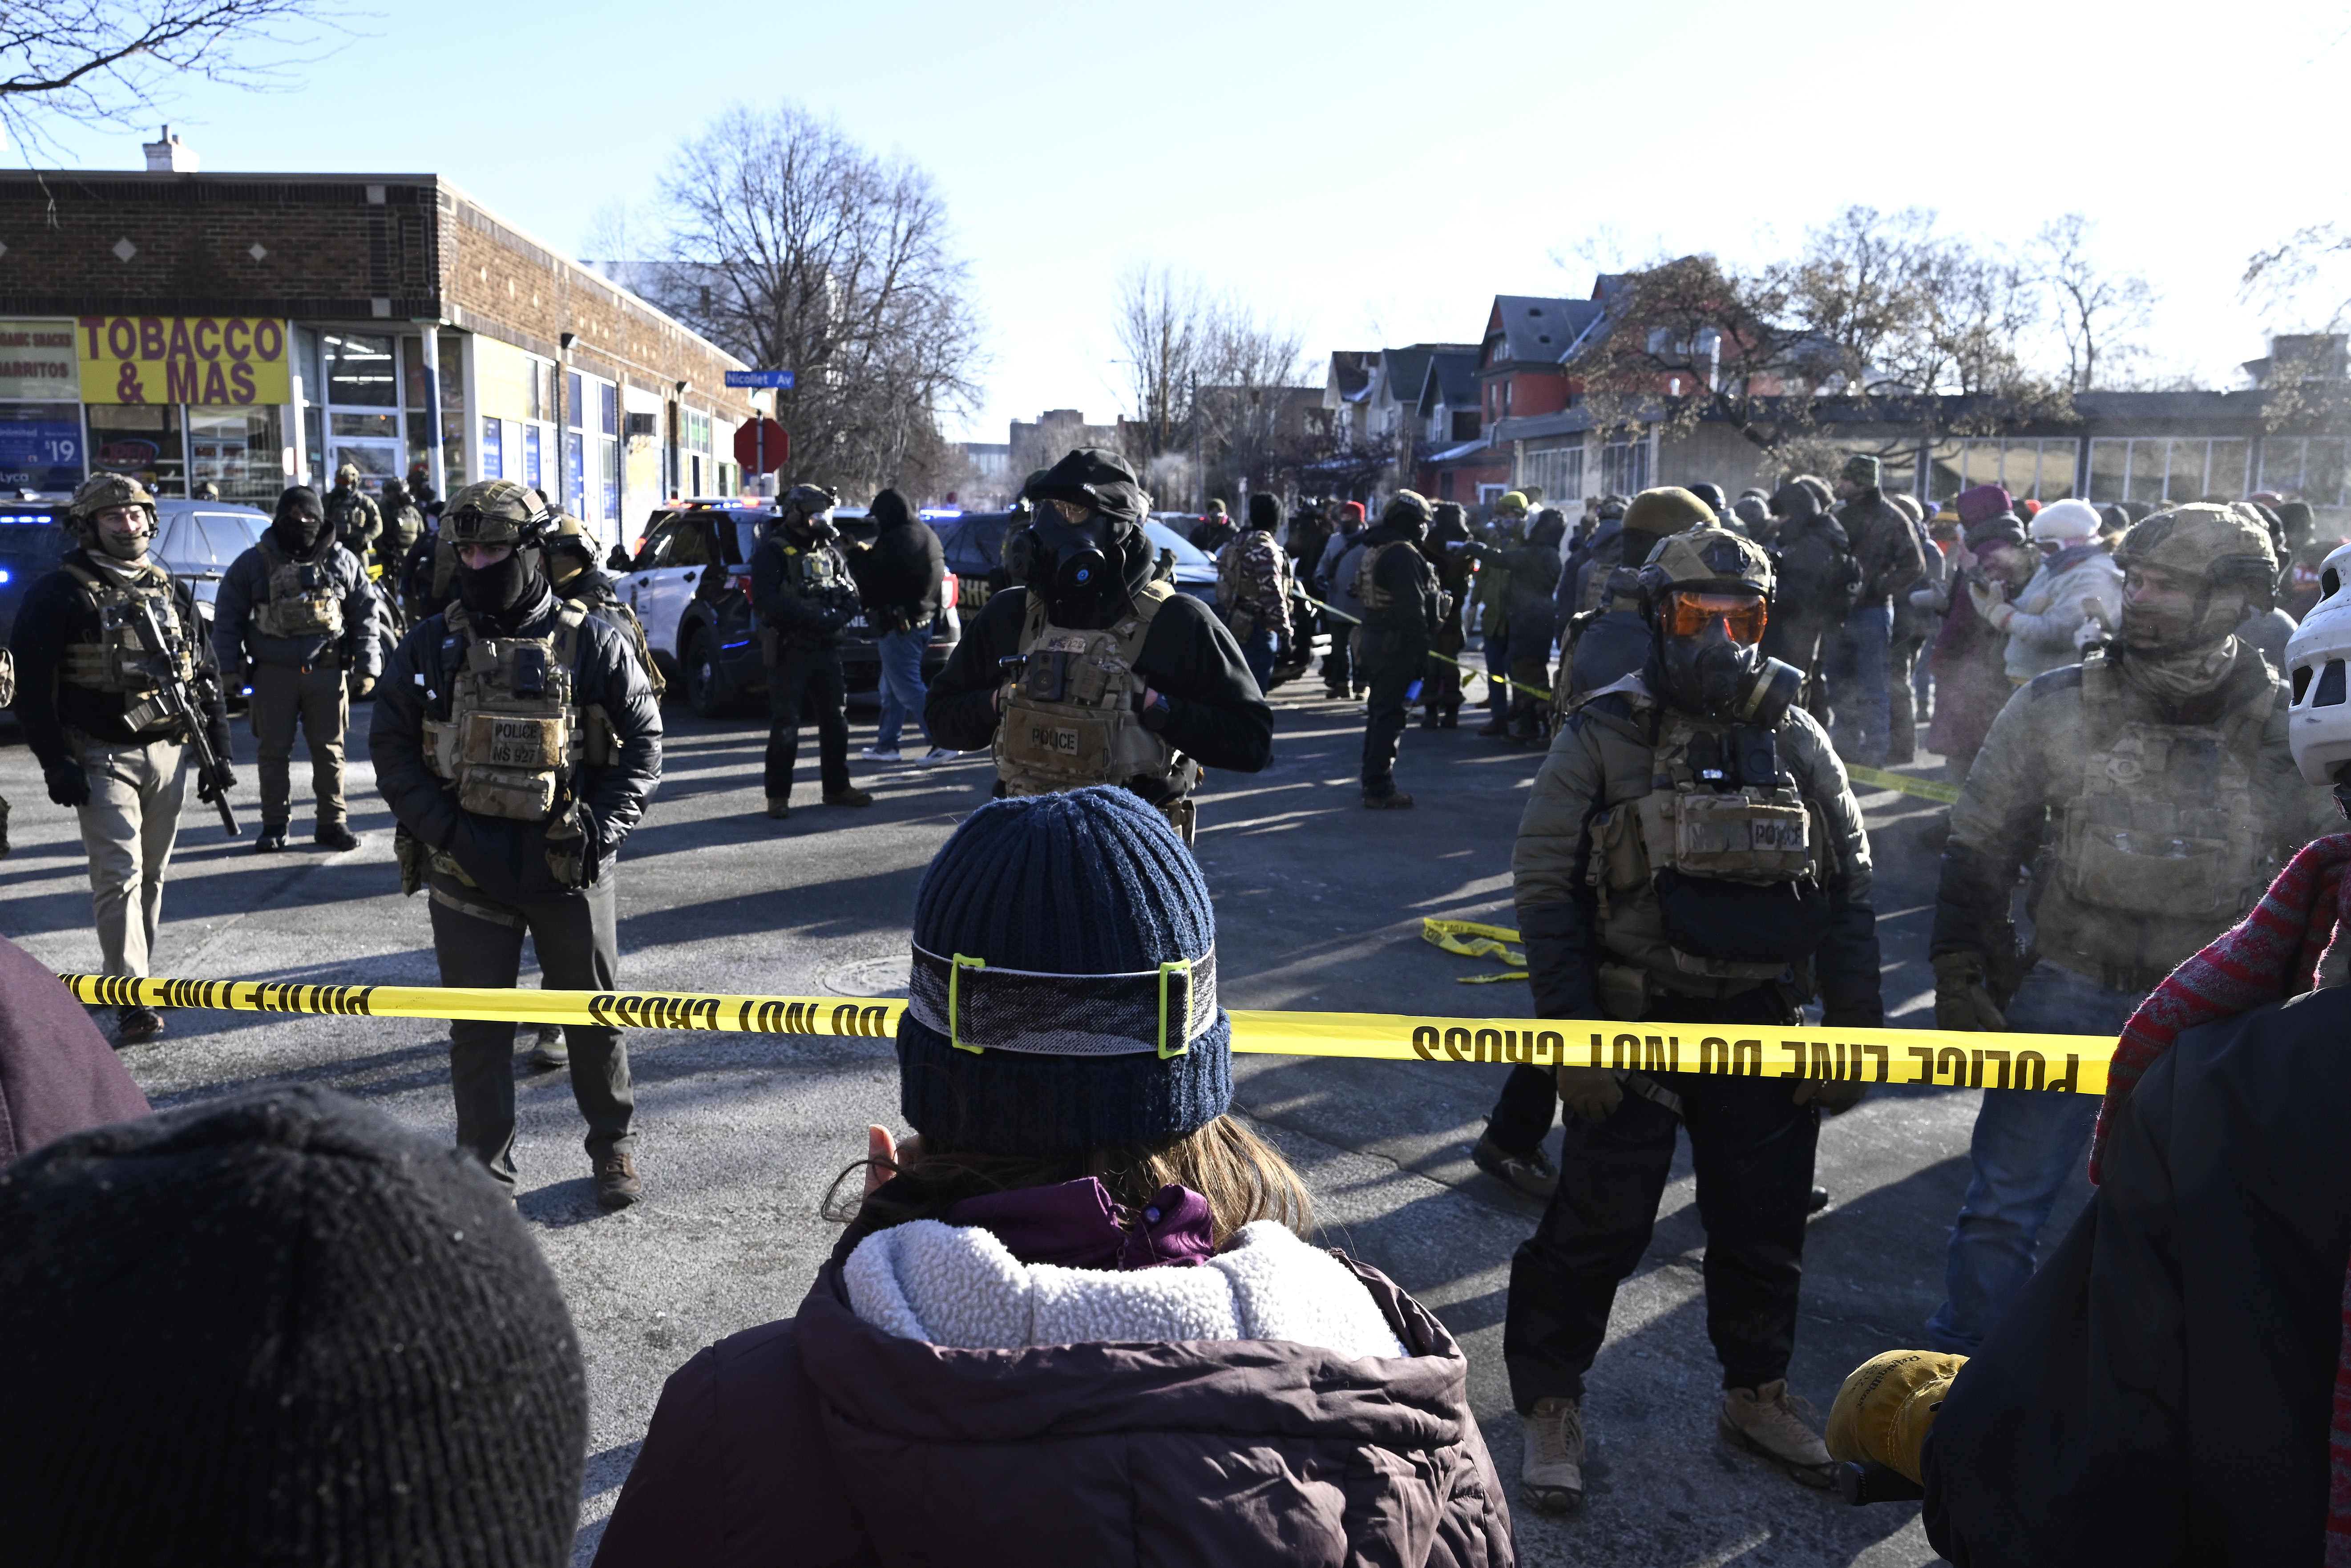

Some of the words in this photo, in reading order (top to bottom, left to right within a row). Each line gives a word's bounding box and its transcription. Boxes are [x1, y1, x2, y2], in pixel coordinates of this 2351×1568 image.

[79, 317, 282, 361] TOBACCO
[117, 361, 145, 404] &
[166, 360, 256, 404] MAS
[495, 723, 537, 739] POLICE
[1032, 727, 1075, 750] POLICE
[493, 747, 511, 762] NS
[1412, 1026, 1564, 1067] CROSS
[1700, 1037, 1761, 1076] DO
[1781, 1040, 1888, 1083] LINE
[1908, 1046, 2079, 1092] POLICE
